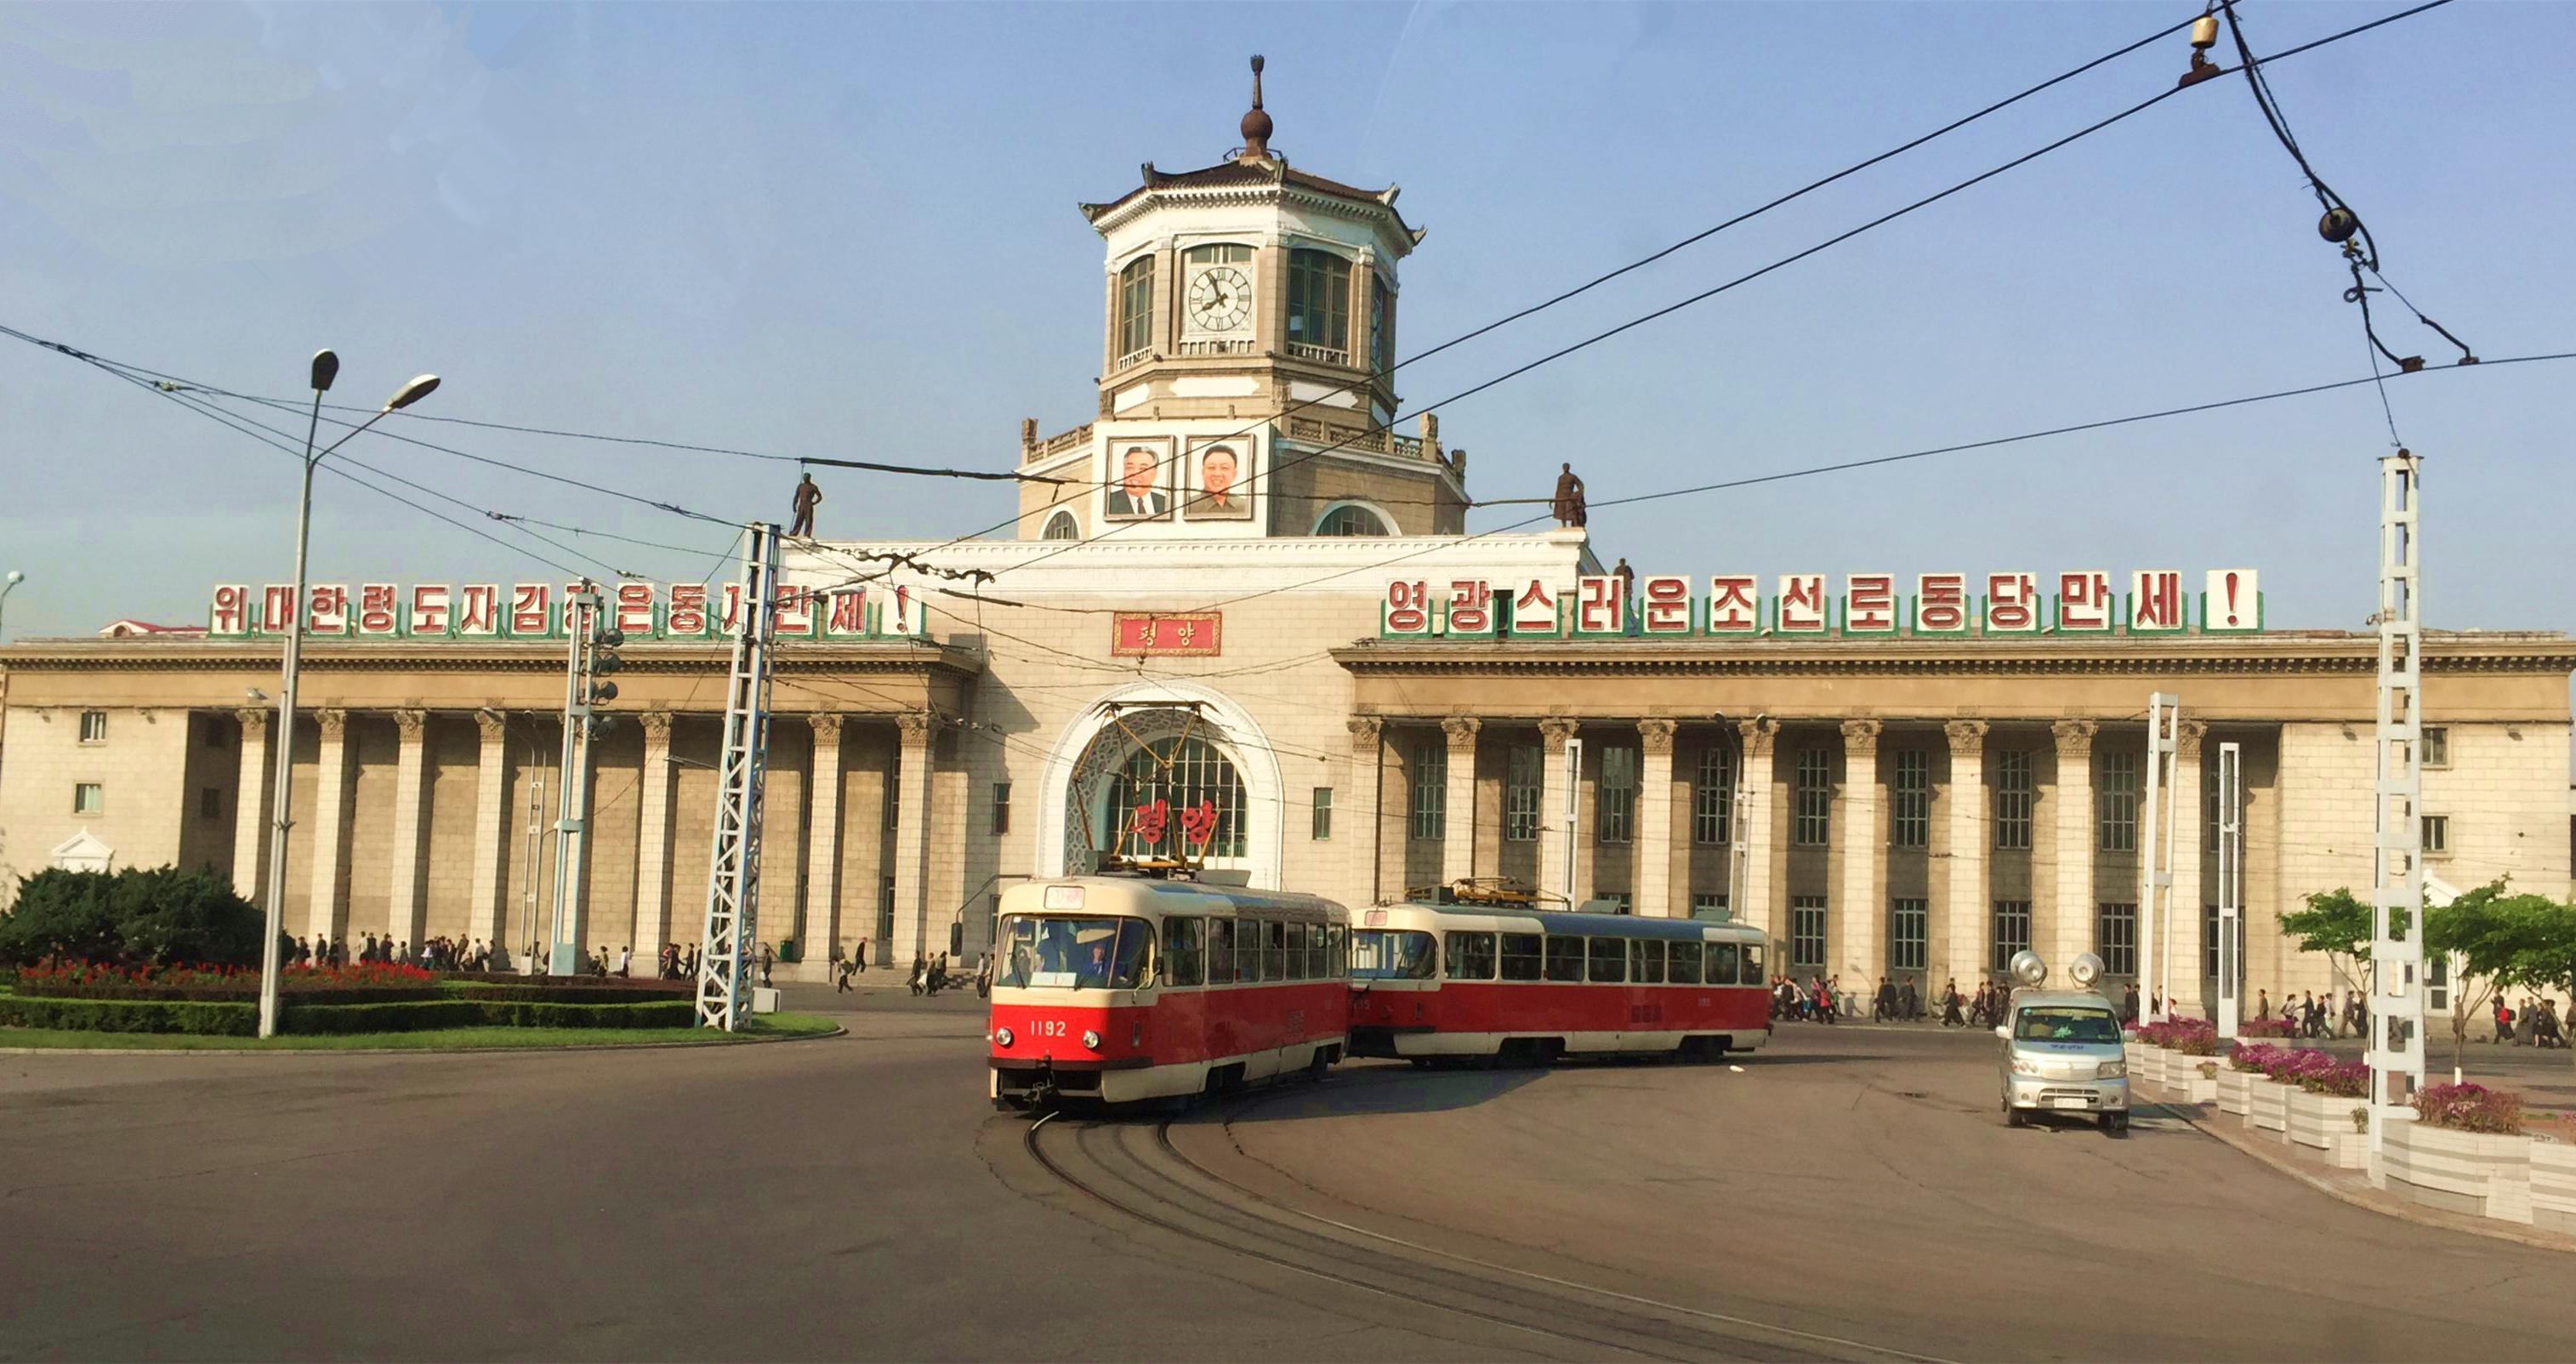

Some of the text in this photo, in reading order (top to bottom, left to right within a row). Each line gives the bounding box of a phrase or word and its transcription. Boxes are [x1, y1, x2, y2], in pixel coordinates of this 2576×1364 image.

[1138, 621, 1195, 646] 평양
[1130, 799, 1218, 844] 평양
[1031, 1020, 1066, 1037] 1192
